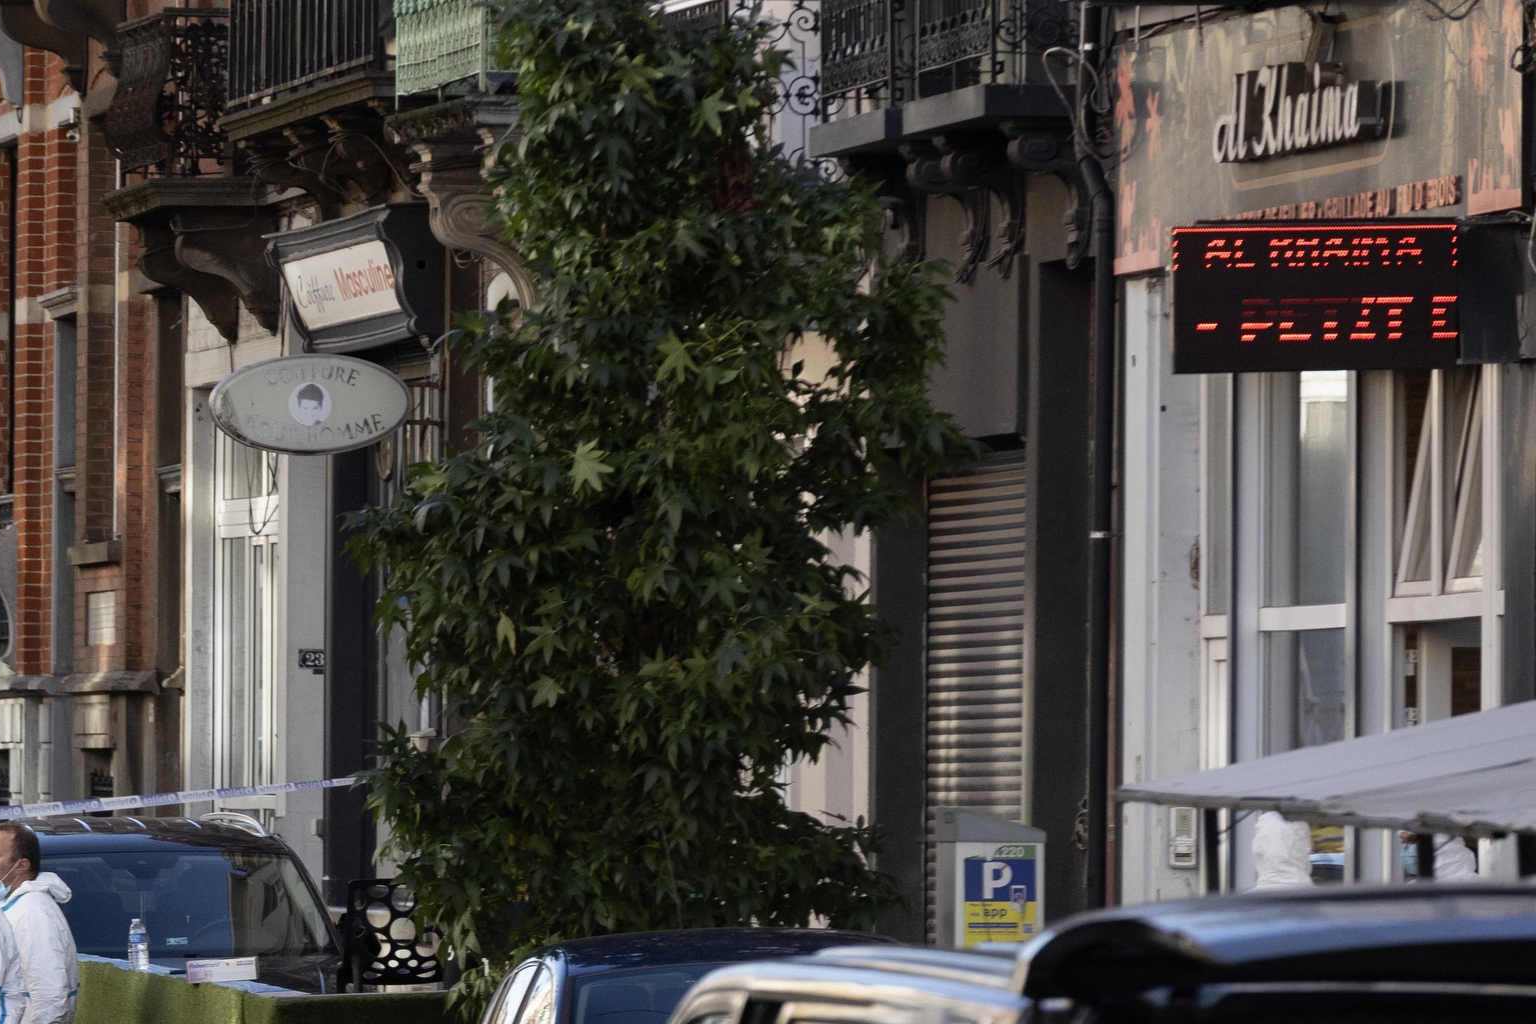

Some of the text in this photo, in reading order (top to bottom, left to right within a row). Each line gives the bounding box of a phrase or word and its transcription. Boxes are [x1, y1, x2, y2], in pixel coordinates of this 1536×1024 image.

[333, 258, 395, 301] Masculine
[305, 652, 325, 666] 23
[984, 861, 1012, 899] P
[983, 908, 1007, 919] app
